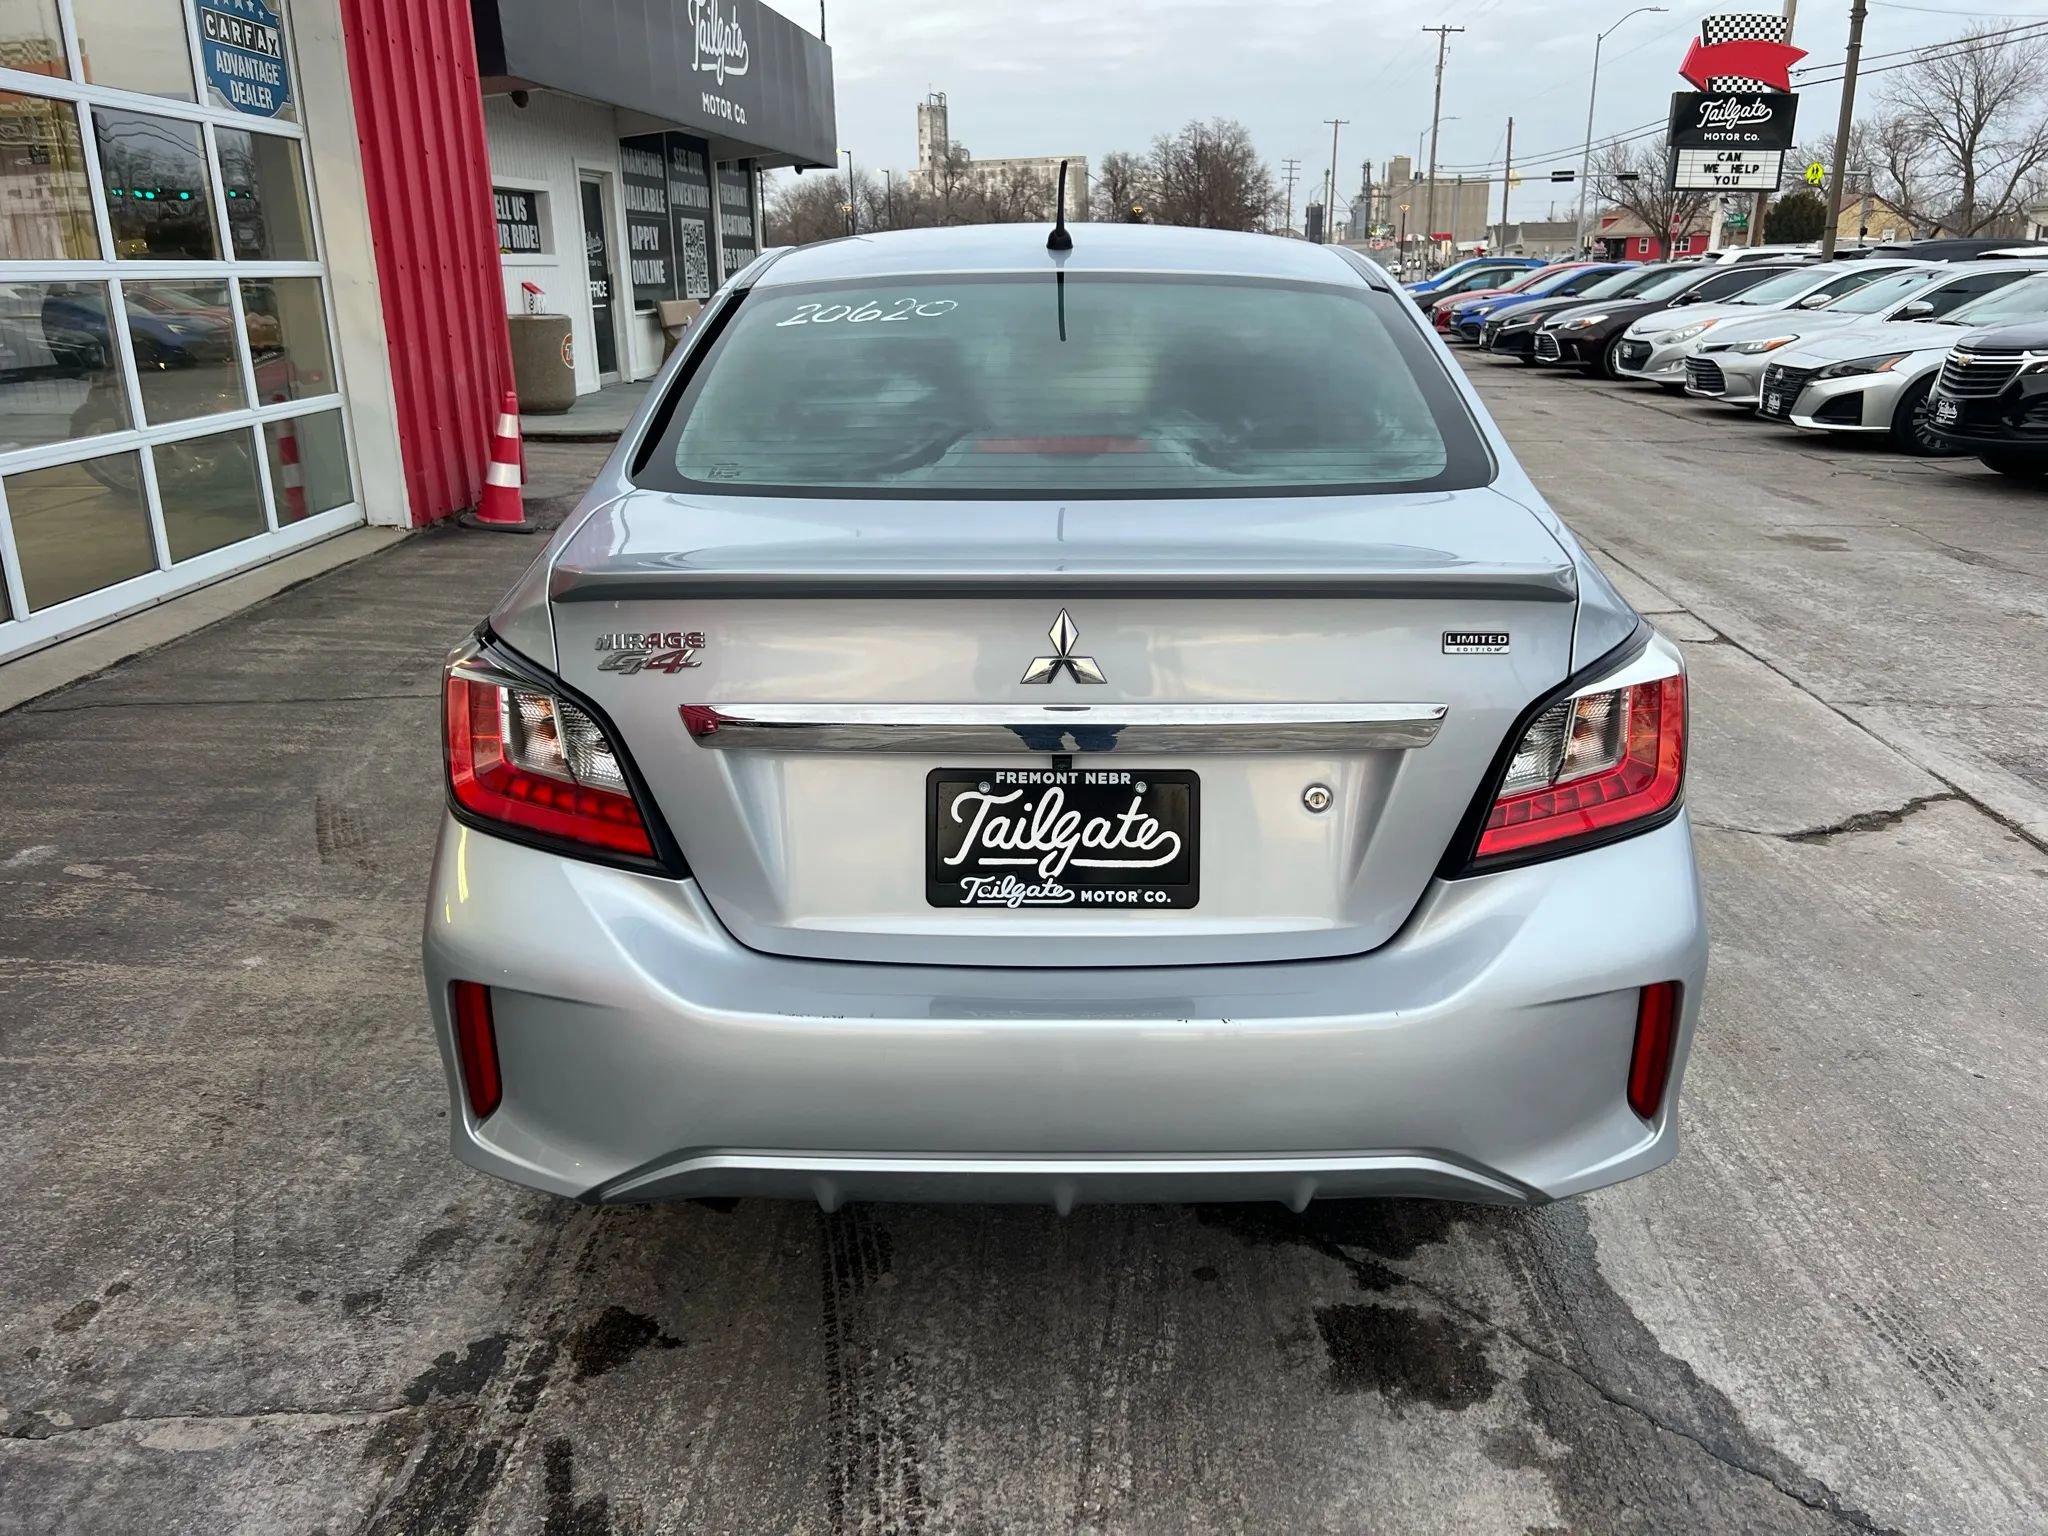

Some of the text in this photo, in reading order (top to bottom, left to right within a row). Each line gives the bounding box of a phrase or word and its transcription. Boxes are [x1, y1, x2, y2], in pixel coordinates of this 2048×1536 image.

[205, 14, 279, 57] CARFAX
[688, 0, 749, 86] Tailgate
[215, 49, 281, 86] ADVANTAGE
[230, 80, 274, 110] DEALER
[702, 91, 748, 125] MOTOR CO.
[1696, 97, 1773, 130] Tailgate
[1703, 132, 1740, 141] MOTOR
[1703, 164, 1760, 174] WE HELP
[1717, 152, 1742, 162] CAN
[1714, 175, 1740, 186] YOU
[494, 192, 528, 222] ELL US
[670, 181, 710, 209] INVENTORY
[510, 224, 540, 249] RIDE!
[631, 225, 659, 250] APPLY
[632, 259, 666, 285] ONLINE
[776, 298, 959, 327] 20620
[595, 631, 706, 651] MIRAGE
[1447, 635, 1508, 644] LIMITED
[597, 649, 703, 675] G4
[996, 771, 1131, 785] FREMONT NEBR
[943, 786, 1181, 879] Tailgate
[960, 875, 1171, 908] Tailgate MOTOR CO.
